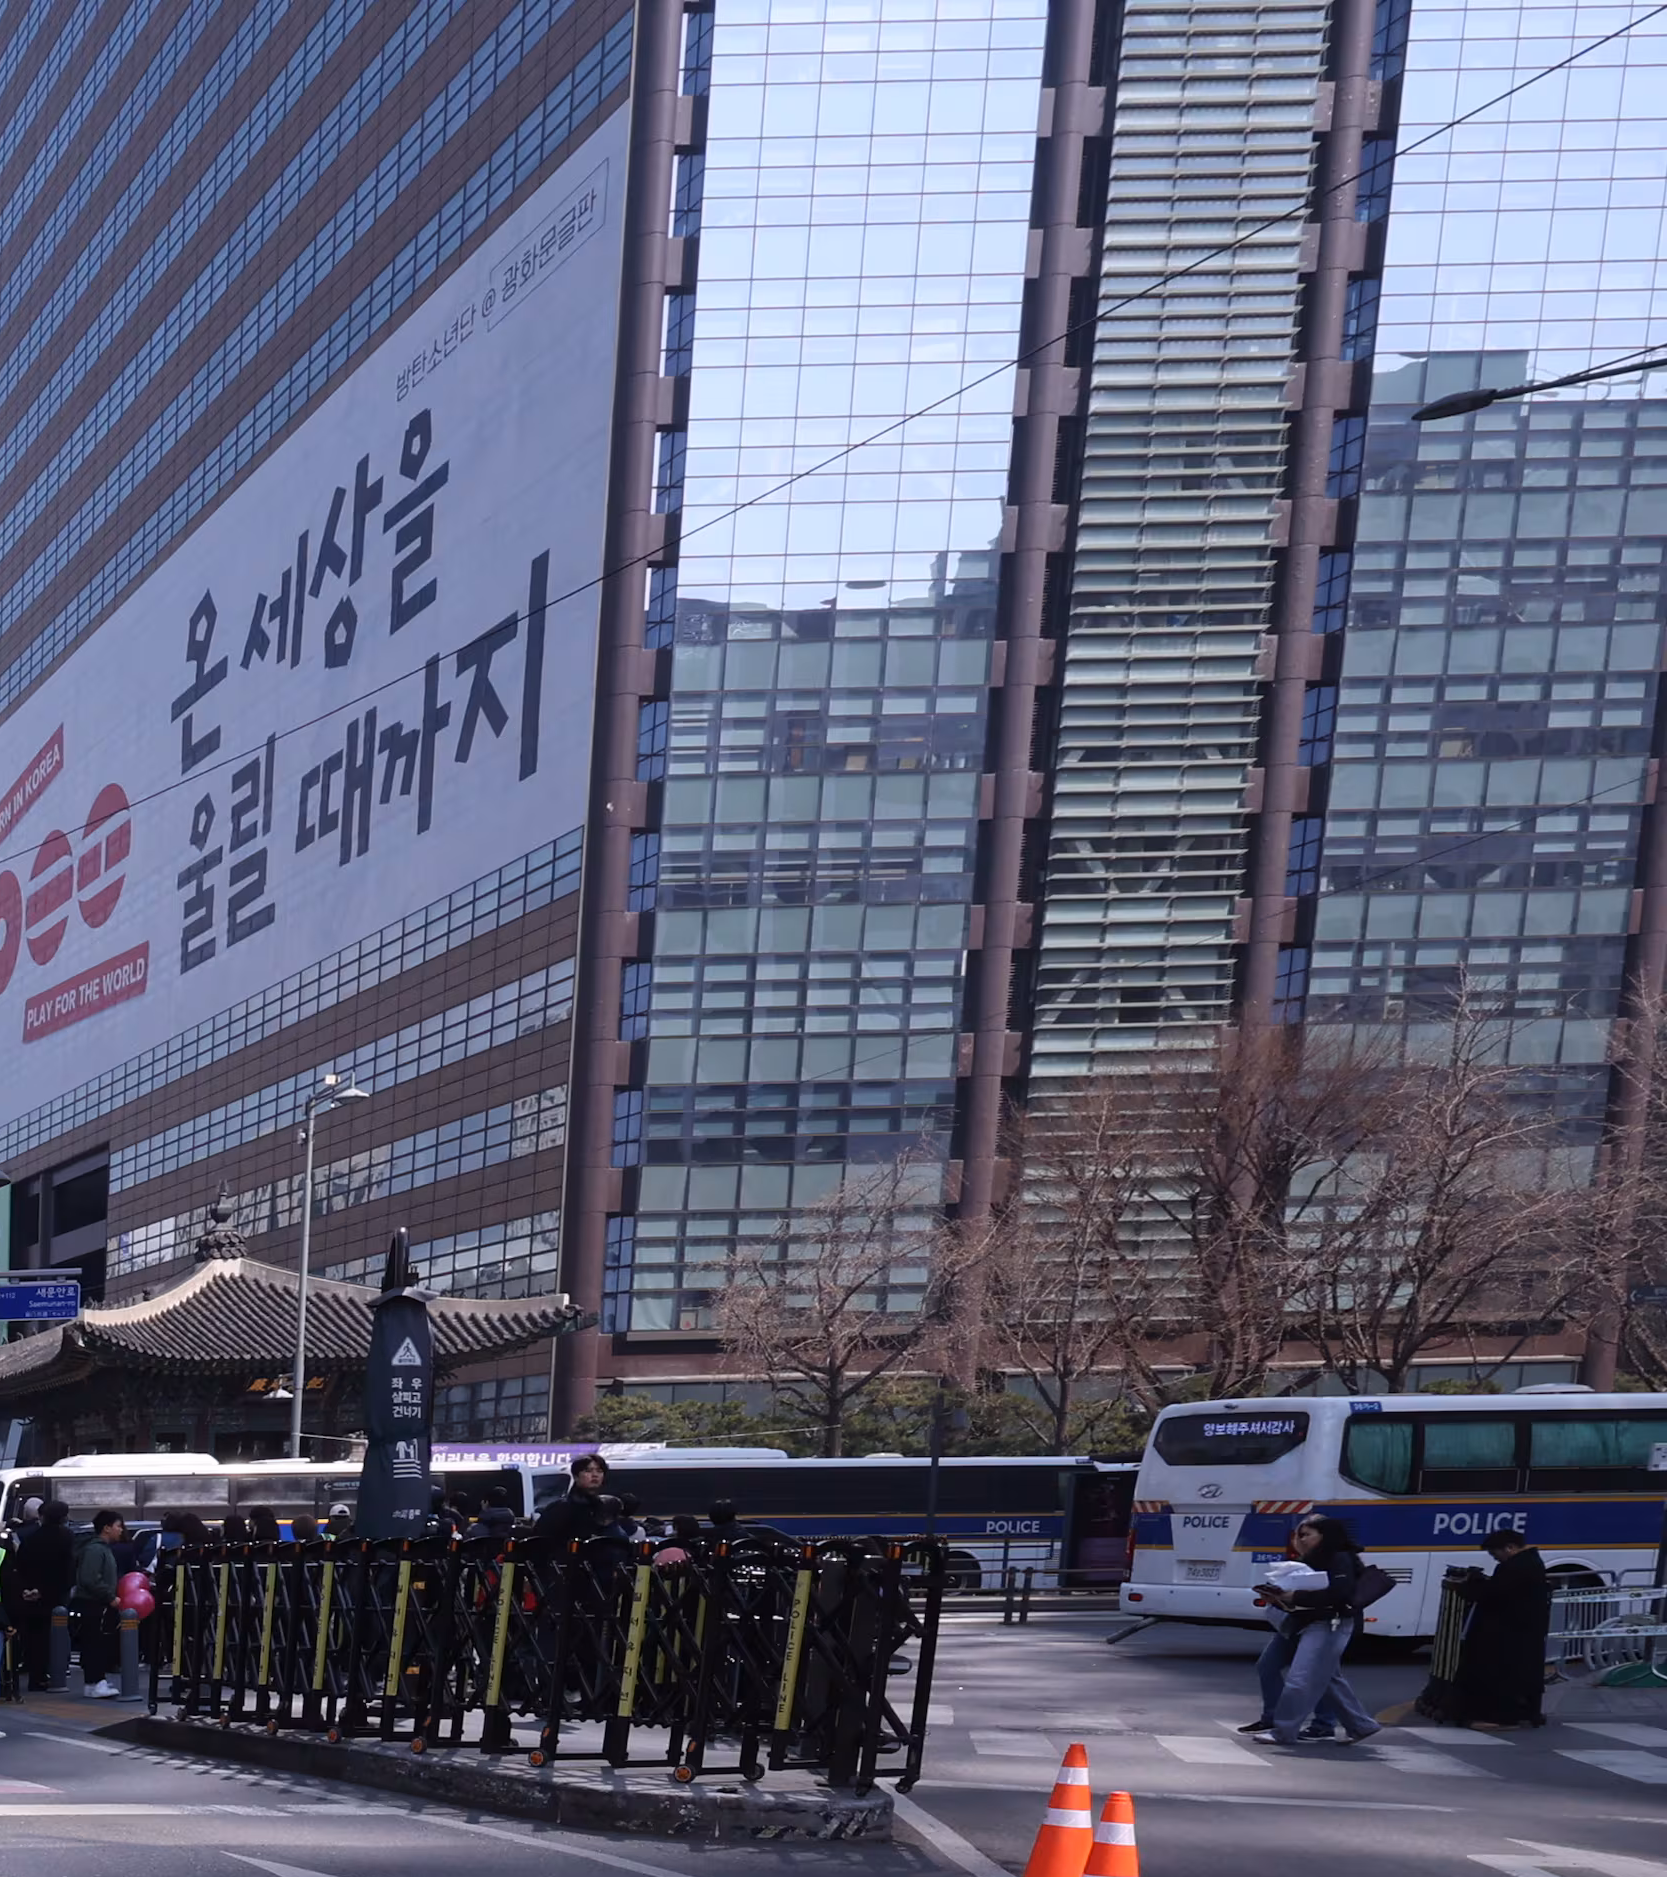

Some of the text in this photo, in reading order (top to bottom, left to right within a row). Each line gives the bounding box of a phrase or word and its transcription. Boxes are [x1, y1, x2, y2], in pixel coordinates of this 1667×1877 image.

[396, 303, 477, 403] 방탄소년단
[501, 187, 597, 303] 광화문글판
[171, 408, 450, 776] 온 세상을
[12, 787, 24, 814] IN
[24, 743, 61, 797] KOREA
[177, 549, 550, 975] 울릴 때까지
[26, 958, 145, 1031] PLAY FOR THE WORLD
[36, 1287, 75, 1299] 새문안로
[391, 1391, 422, 1404] 살피고
[392, 1405, 421, 1418] 건너기
[986, 1520, 1041, 1534] POLICE
[1182, 1514, 1230, 1529] POLICE
[1433, 1512, 1527, 1535] POLICE
[778, 1598, 801, 1713] POLICE LINE
